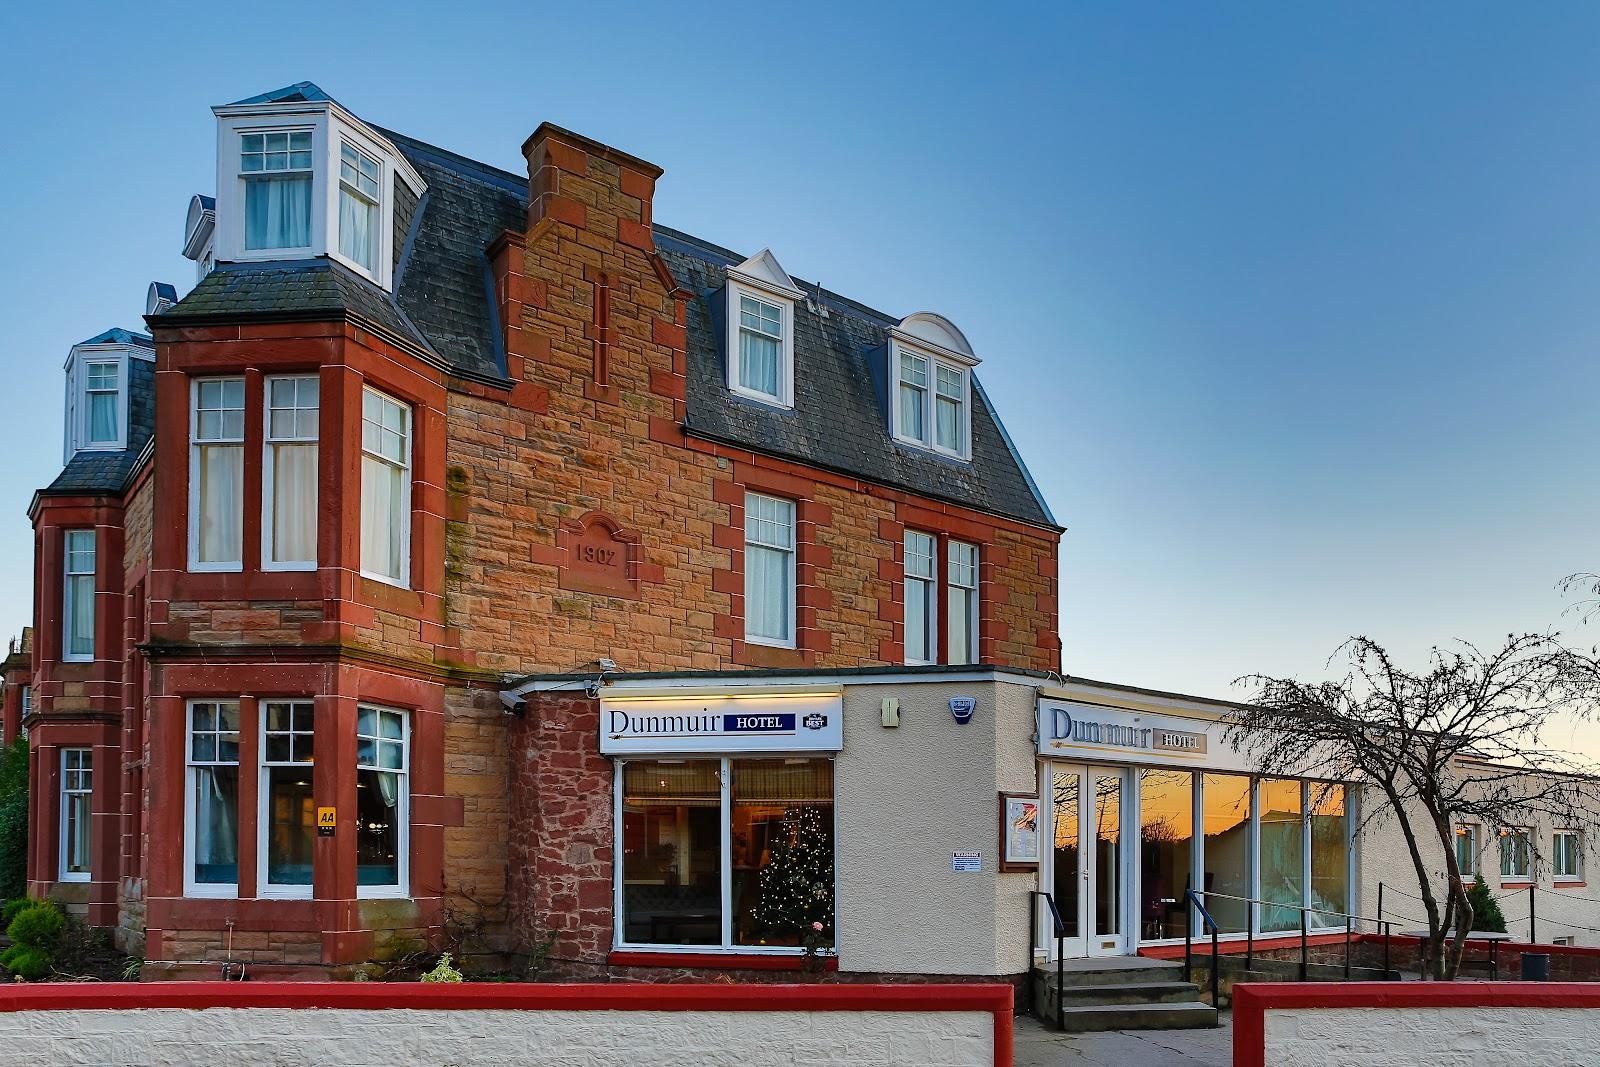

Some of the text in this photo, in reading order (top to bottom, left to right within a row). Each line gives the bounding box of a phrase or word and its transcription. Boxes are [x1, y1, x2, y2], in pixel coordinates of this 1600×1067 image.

[608, 707, 783, 734] Dunmuir HOTEL
[805, 719, 825, 728] BEST
[1049, 707, 1200, 750] Dunmuir HOTEL
[320, 812, 335, 823] AA
